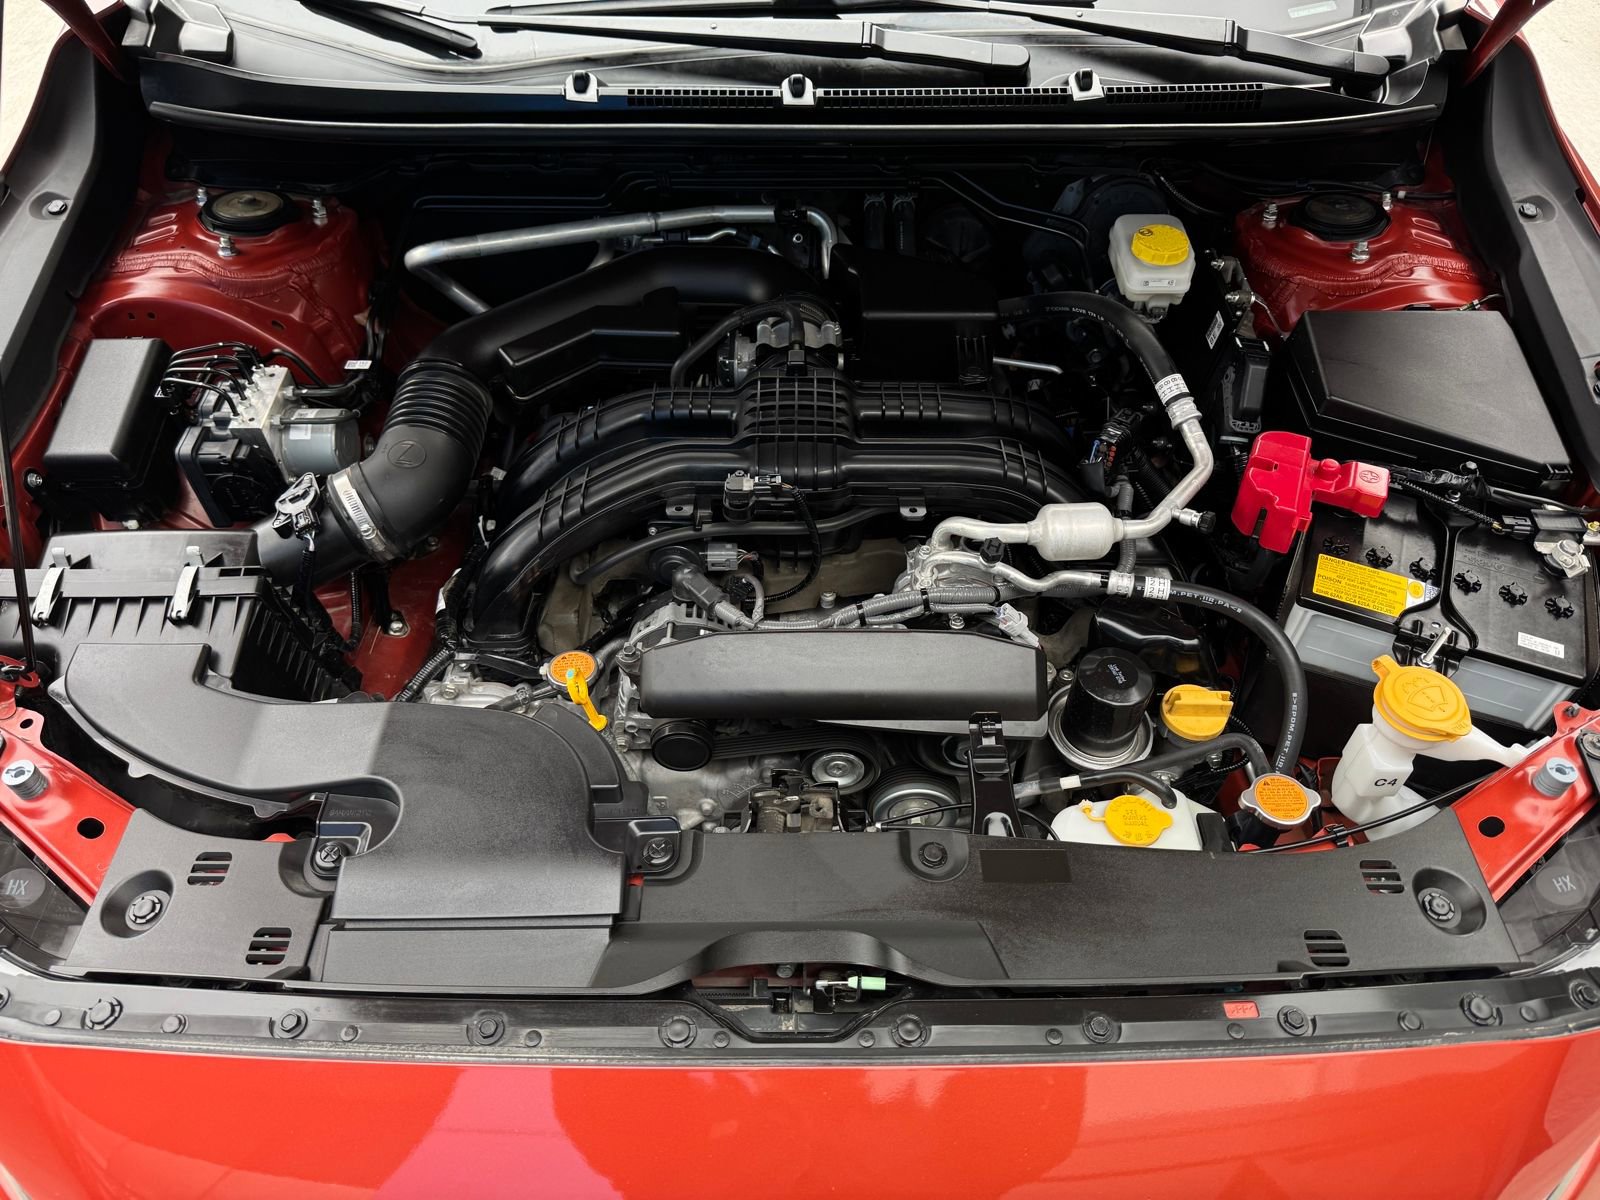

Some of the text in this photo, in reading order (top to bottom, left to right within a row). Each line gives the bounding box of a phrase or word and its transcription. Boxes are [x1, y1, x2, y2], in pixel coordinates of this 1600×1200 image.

[1320, 555, 1346, 565] DANGER
[1317, 574, 1342, 584] POISON
[1374, 778, 1398, 786] C4
[5, 879, 29, 895] HX
[1552, 874, 1576, 892] HX
